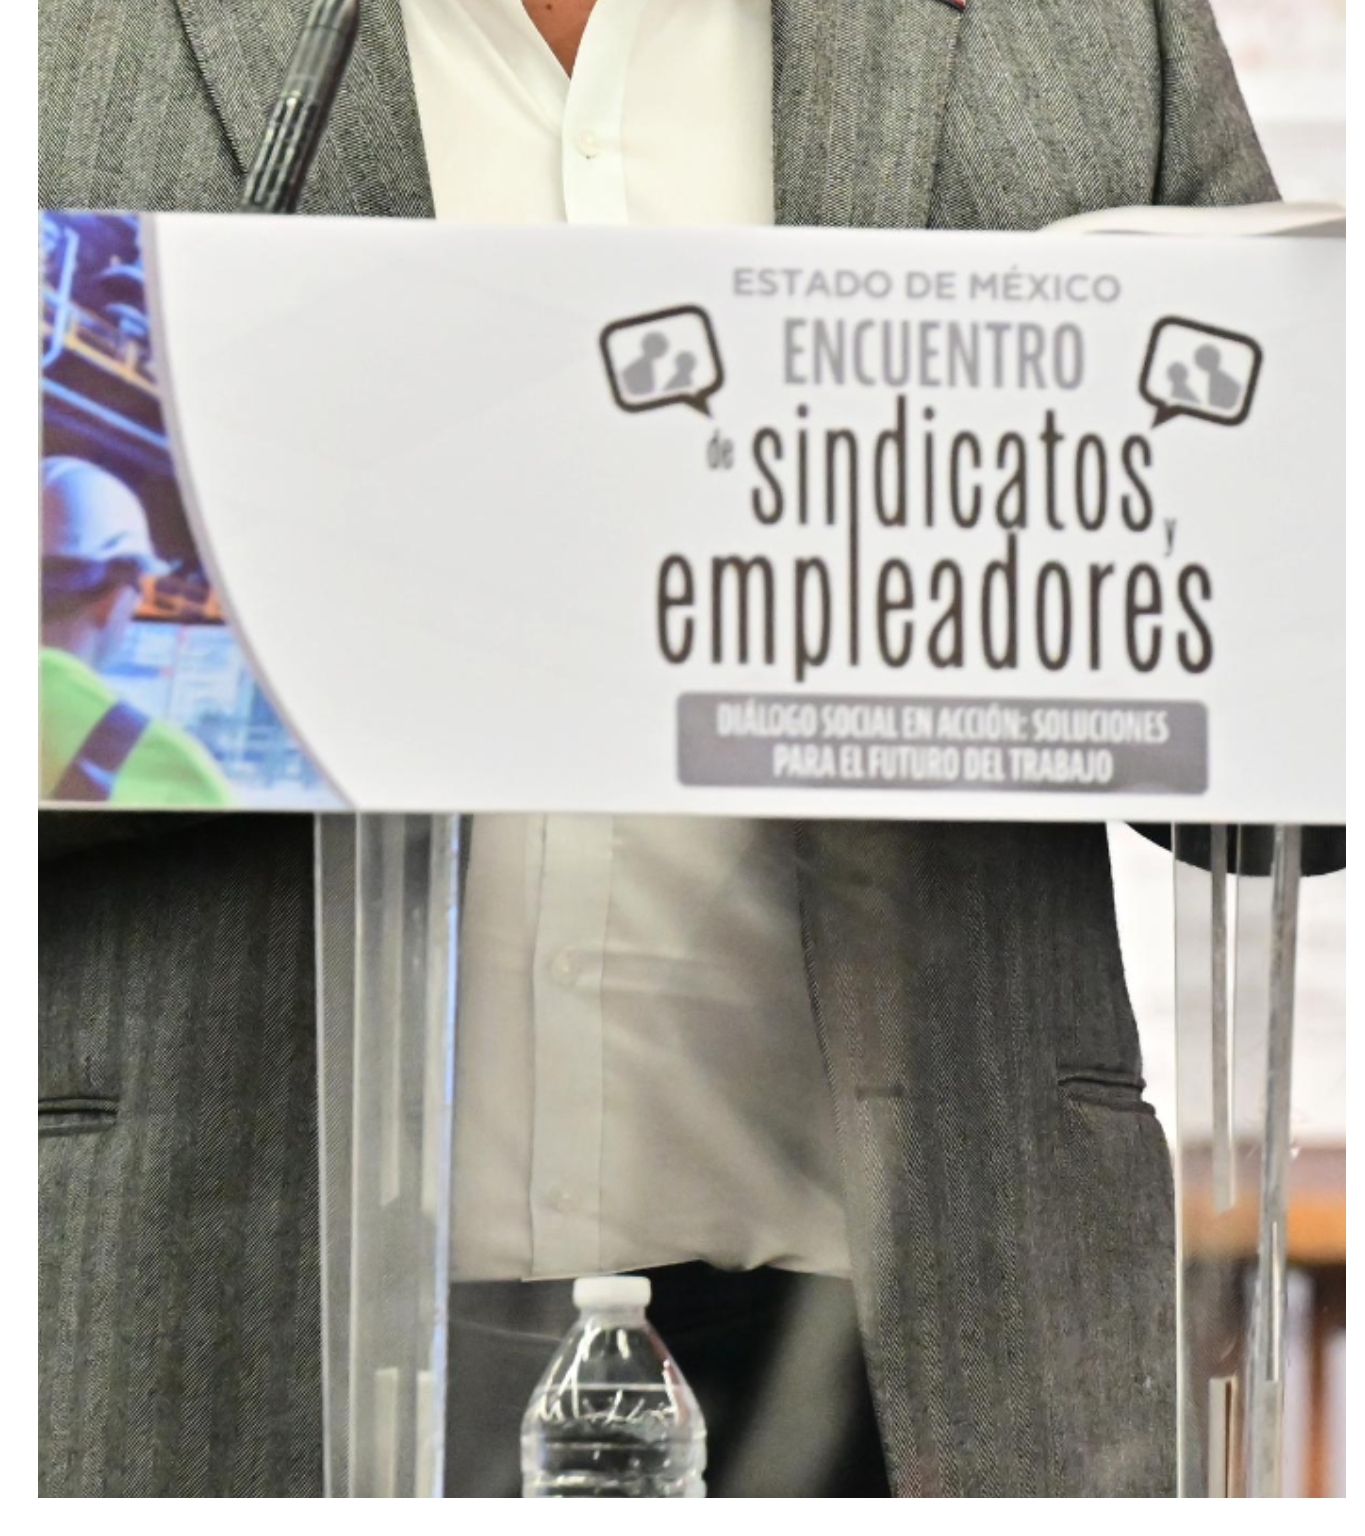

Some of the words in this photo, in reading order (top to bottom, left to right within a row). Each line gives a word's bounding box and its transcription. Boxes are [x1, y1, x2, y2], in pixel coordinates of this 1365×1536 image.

[733, 266, 892, 299] ESTADO
[905, 271, 956, 301] DE
[969, 265, 1121, 304] MÉXICO
[783, 316, 1085, 392] ENCUENTRO
[705, 427, 735, 472] de
[750, 394, 1155, 534] sindicatos
[1163, 517, 1178, 558] y
[655, 532, 1215, 685] empleadores
[716, 698, 818, 738] DIÁLOGO
[822, 705, 899, 740] SOCIAL
[903, 706, 934, 741] EN
[937, 701, 1028, 742] ACCIÓN:
[1032, 707, 1170, 745] SOLUCIONES
[773, 745, 837, 779] PARA
[840, 746, 865, 780] EL
[868, 747, 961, 782] FUTURO
[963, 747, 1005, 783] DEL
[1008, 748, 1114, 784] TRABAJO
